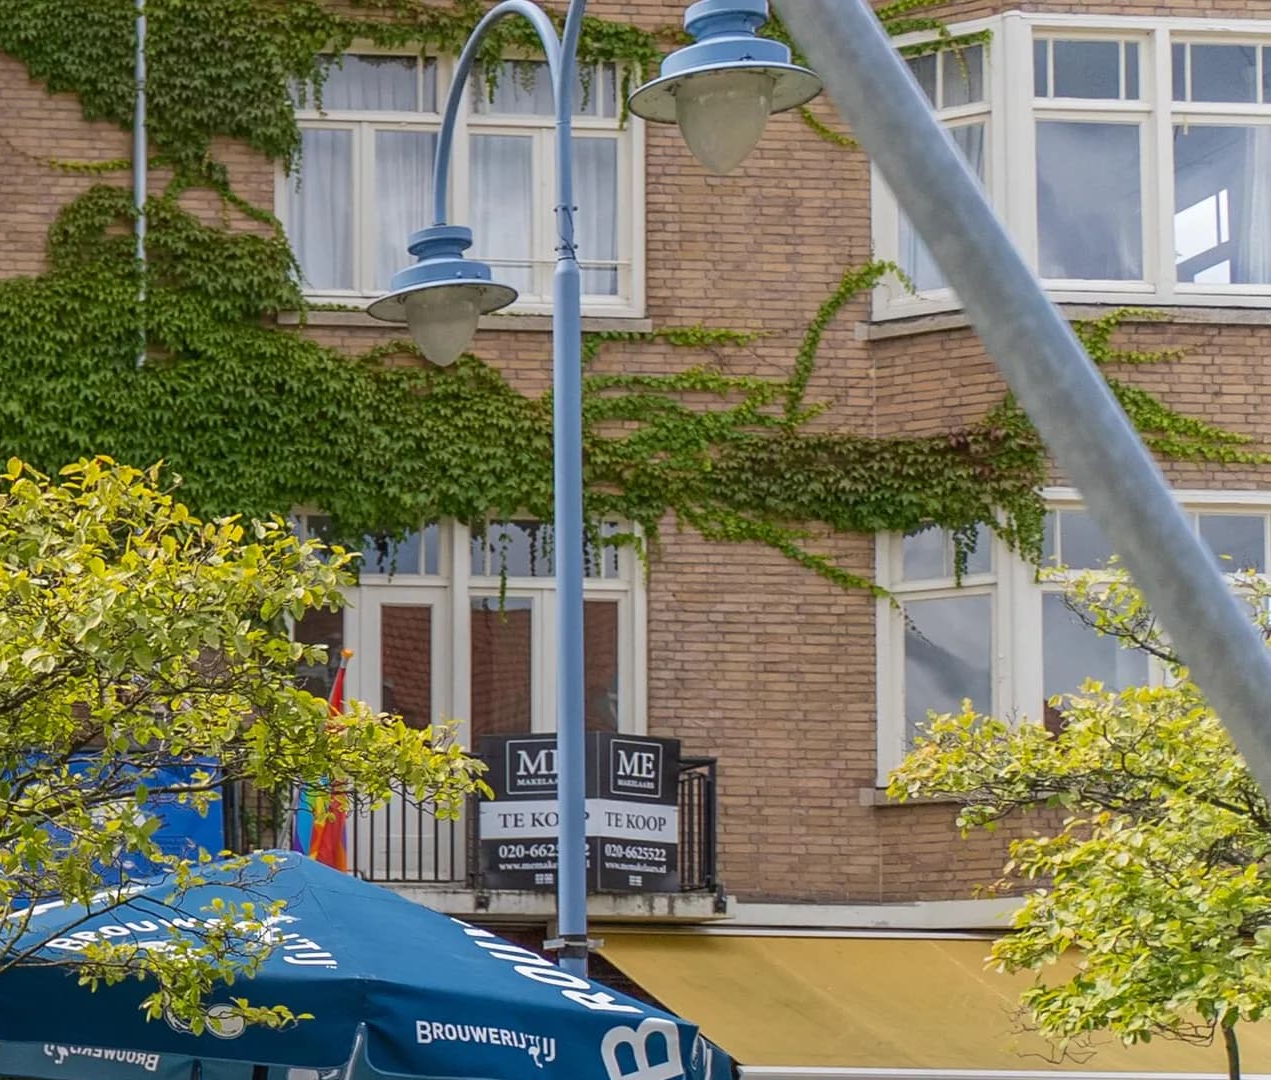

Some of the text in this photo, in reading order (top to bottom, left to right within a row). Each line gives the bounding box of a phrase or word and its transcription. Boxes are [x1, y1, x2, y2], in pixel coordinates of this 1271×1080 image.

[617, 750, 655, 778] ME
[498, 811, 590, 829] TE KO
[605, 811, 667, 831] TE KOOP
[604, 843, 667, 862] 020-6625522
